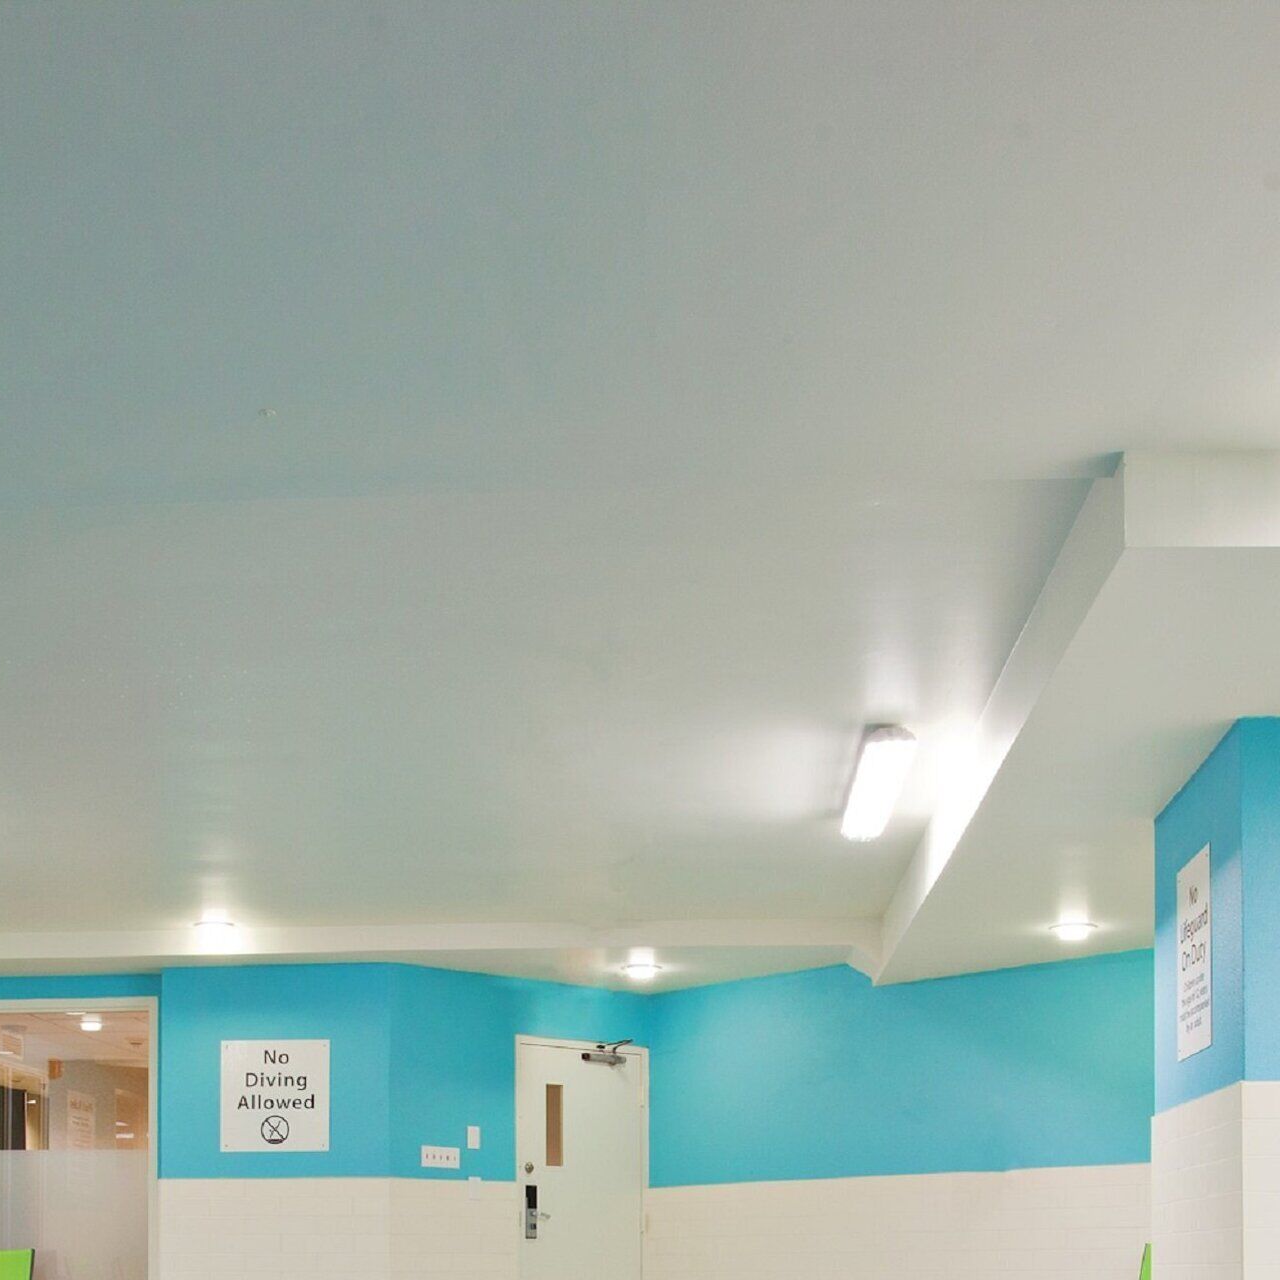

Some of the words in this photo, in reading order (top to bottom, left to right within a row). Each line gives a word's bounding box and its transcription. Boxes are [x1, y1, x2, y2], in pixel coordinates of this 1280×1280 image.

[1189, 886, 1199, 906] No
[264, 1050, 289, 1064] No
[245, 1072, 307, 1091] Diving
[237, 1094, 315, 1110] Allowed
